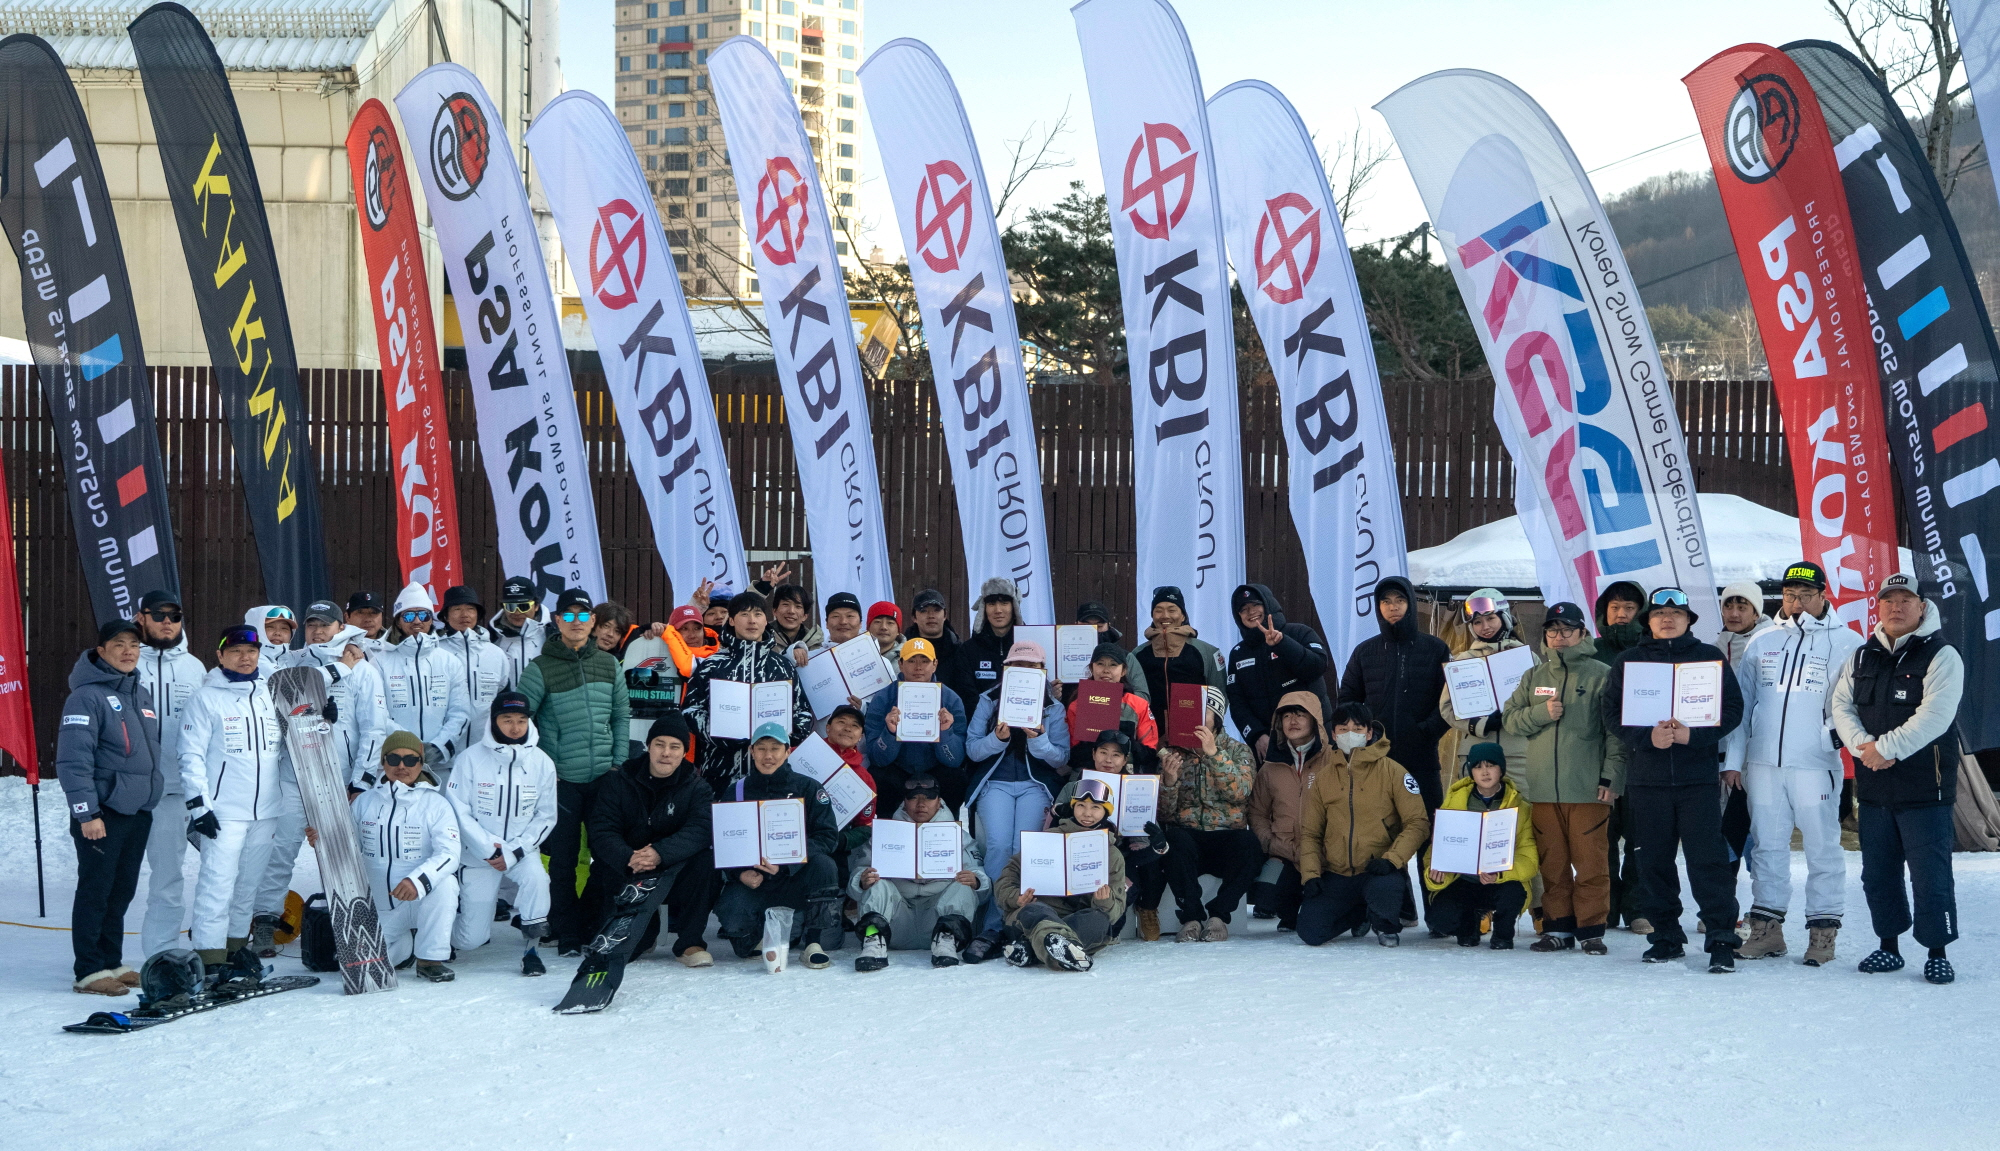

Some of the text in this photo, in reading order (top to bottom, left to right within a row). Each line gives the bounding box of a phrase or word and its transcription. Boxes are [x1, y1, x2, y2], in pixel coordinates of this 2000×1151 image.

[1786, 567, 1816, 579] JETSURF
[849, 660, 877, 679] KSGF
[627, 689, 649, 701] UNiQ
[1634, 688, 1661, 697] KSGF
[1007, 695, 1038, 706] KSGF
[1088, 694, 1111, 703] KSGF
[1681, 693, 1715, 705] KSGF
[757, 709, 786, 719] KSGF
[904, 712, 934, 720] KSGF
[1125, 805, 1152, 814] KSGF
[767, 831, 799, 841] KSGF
[1443, 835, 1469, 844] KSGF
[881, 843, 906, 852] KSGF
[1485, 838, 1510, 850] KSGF
[924, 849, 955, 858] KSGF
[1030, 857, 1055, 867] KSGF
[1072, 861, 1103, 873] KSGF
